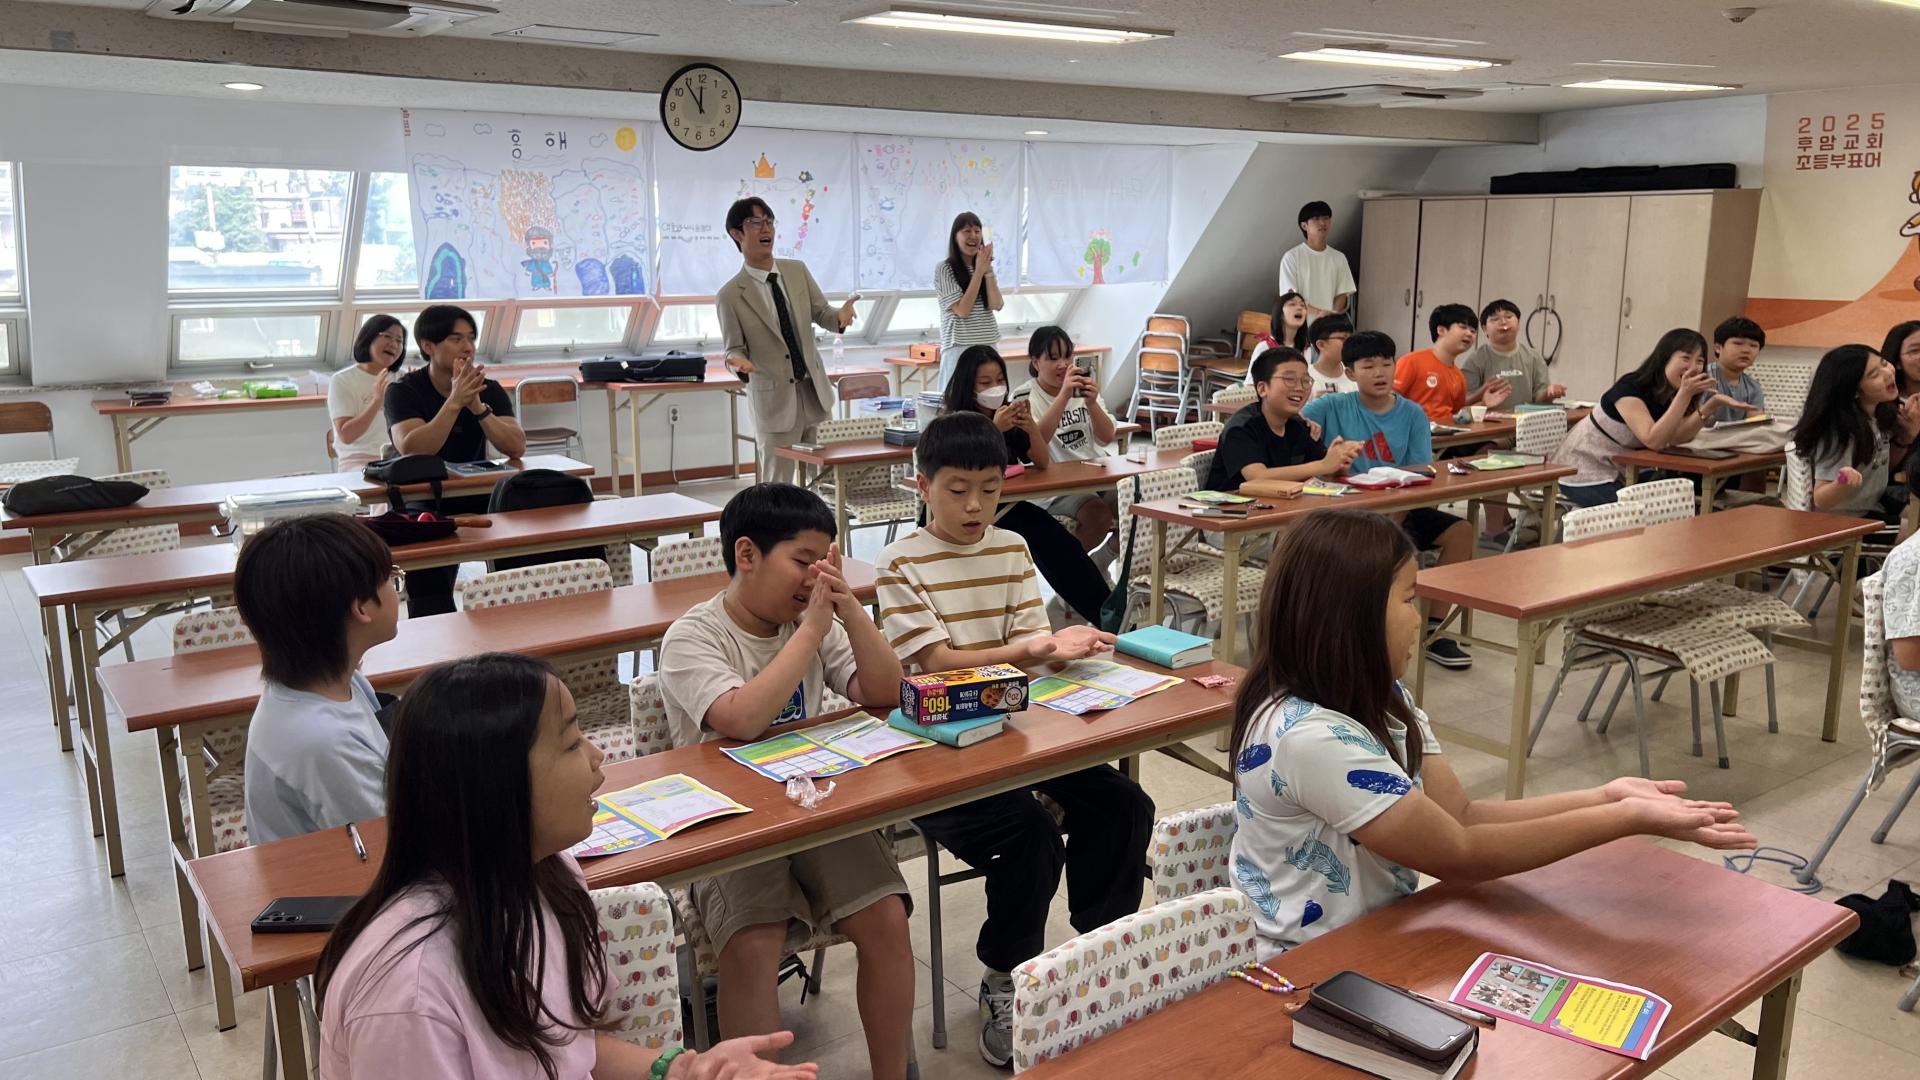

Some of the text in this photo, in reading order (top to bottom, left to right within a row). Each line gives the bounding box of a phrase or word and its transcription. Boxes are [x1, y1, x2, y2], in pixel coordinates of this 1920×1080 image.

[685, 77, 692, 86] 11
[698, 74, 707, 84] 12
[714, 80, 718, 88] 1
[675, 88, 684, 97] 10
[721, 90, 728, 99] 2
[670, 102, 676, 111] 9
[725, 105, 731, 114] 3
[674, 117, 680, 126] 8
[720, 119, 725, 128] 4
[1798, 112, 1885, 134] 2025
[683, 127, 690, 136] 7
[709, 128, 716, 137] 5
[696, 132, 702, 141] 6
[1797, 133, 1884, 152] 후암교회
[1796, 152, 1881, 170] 초등부표어
[923, 695, 952, 712] 160g
